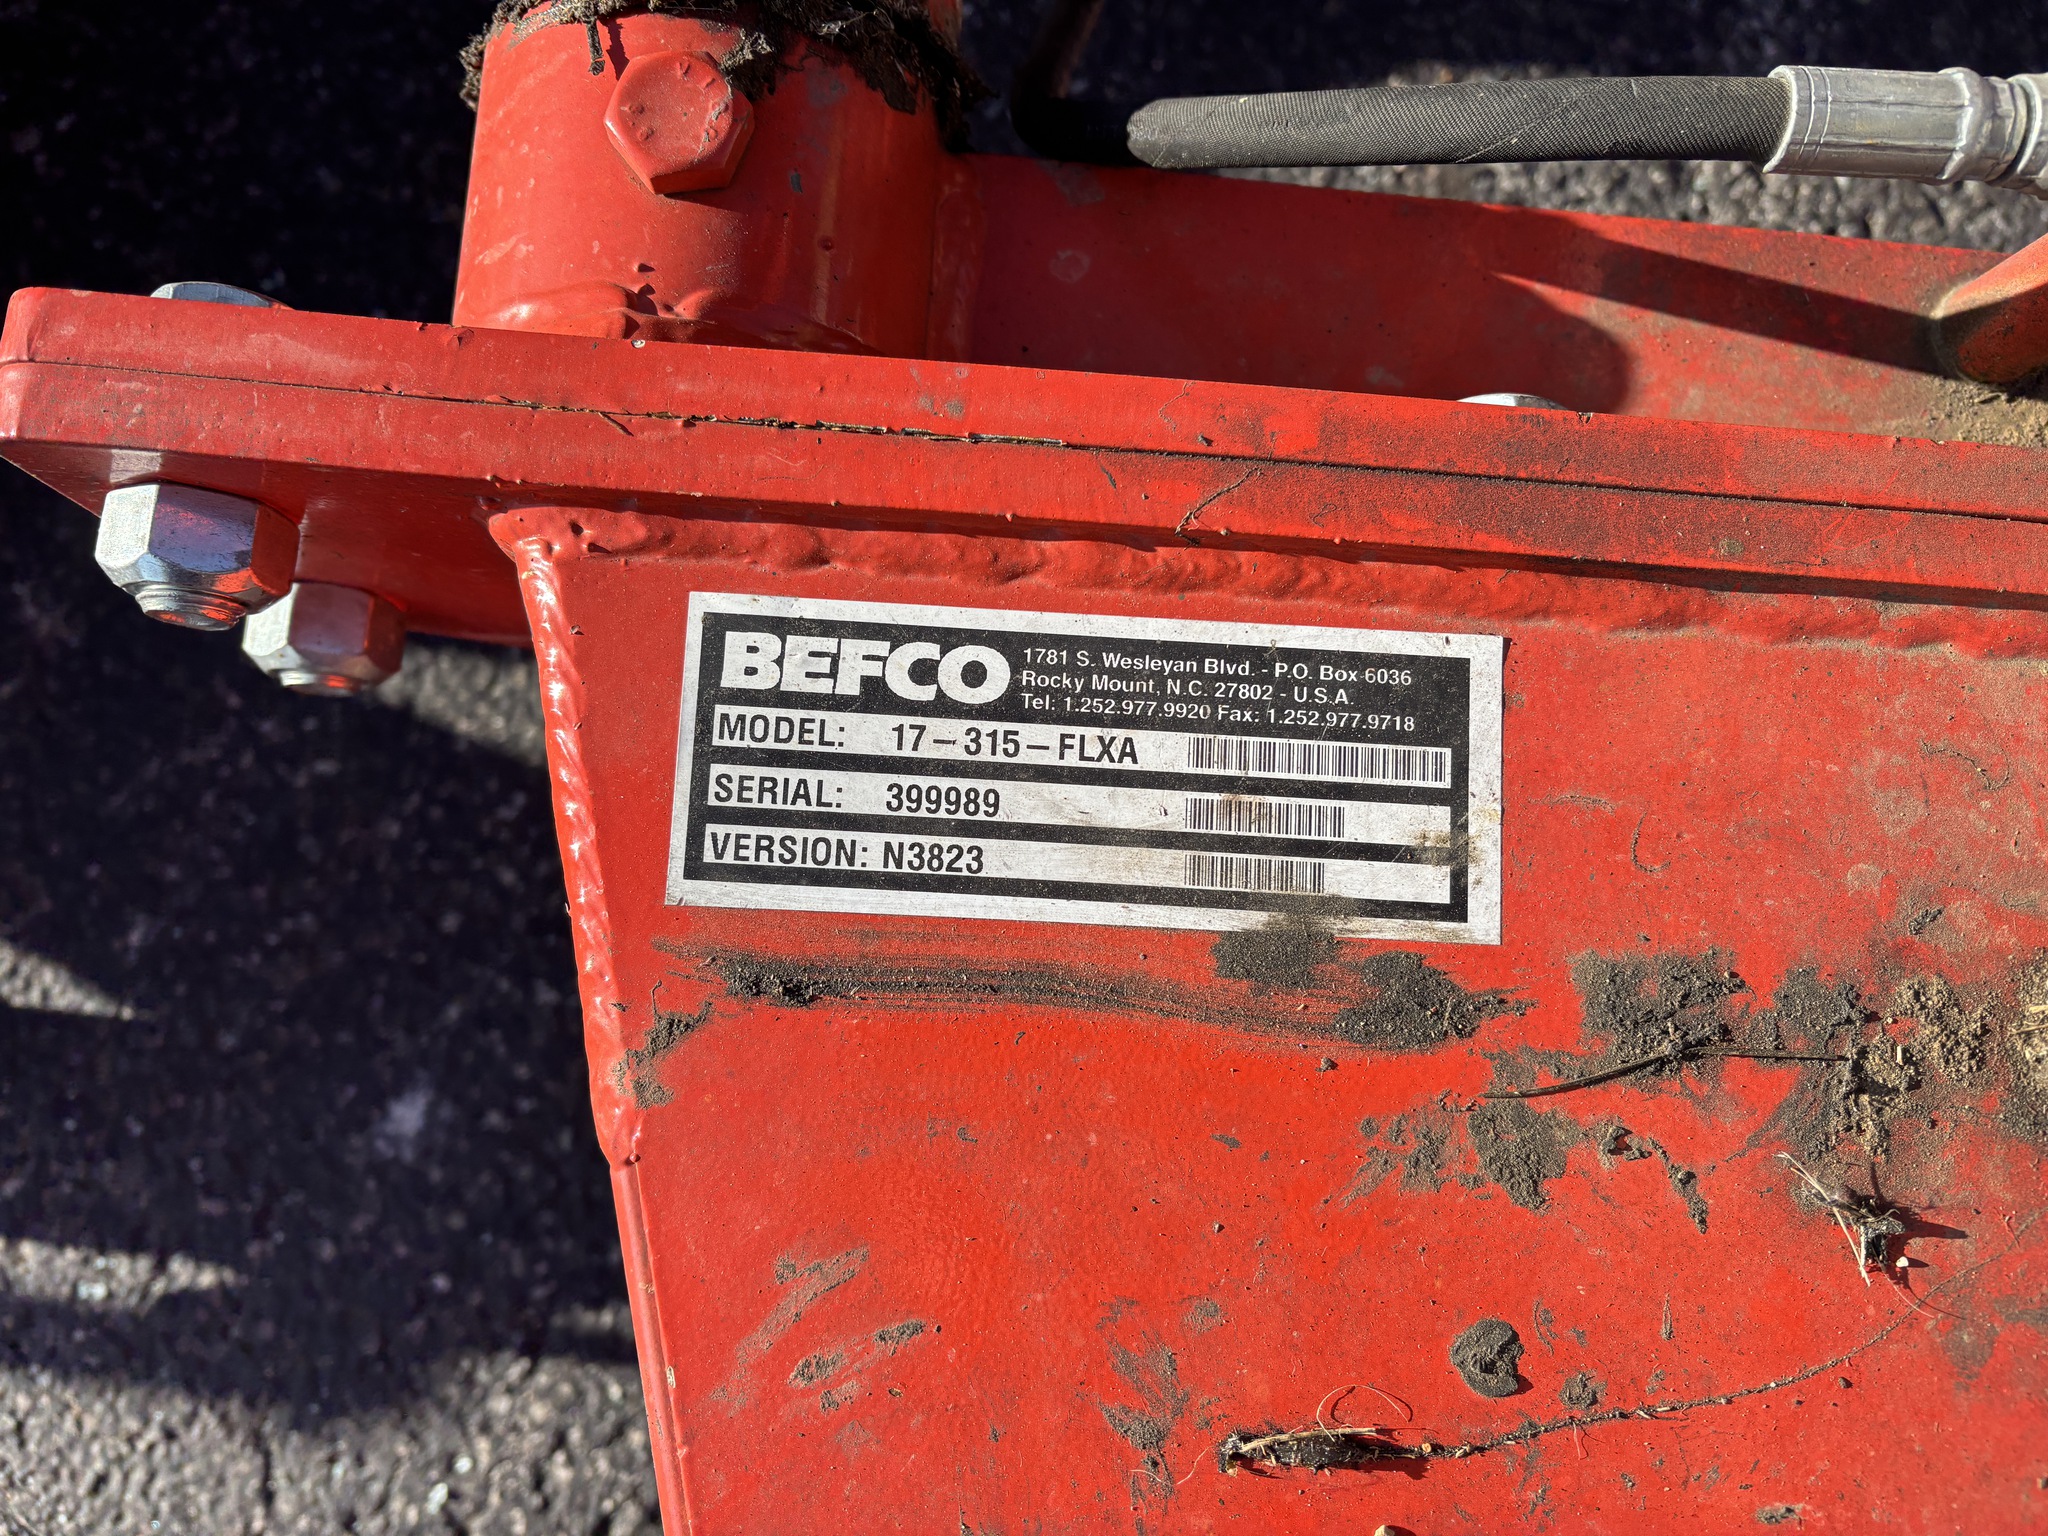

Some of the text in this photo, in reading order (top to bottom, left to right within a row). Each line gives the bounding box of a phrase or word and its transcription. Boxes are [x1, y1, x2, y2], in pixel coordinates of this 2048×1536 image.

[720, 631, 1011, 704] BEFCO
[1022, 670, 1084, 693] Rocky
[1092, 674, 1160, 696] Mount,
[1167, 679, 1208, 697] N.C.
[1214, 682, 1273, 700] 27802
[1293, 686, 1354, 705] U.S.A.
[1023, 648, 1068, 665] 1781
[1076, 650, 1095, 667] S.
[1102, 652, 1197, 675] Wesleyan
[1204, 658, 1255, 676] Blvd.
[1275, 663, 1313, 680] P.O.
[1320, 665, 1358, 682] Box
[1364, 668, 1412, 686] 6036
[1020, 693, 1415, 732] Tel: 1.252.977.9920 Fax: 1.252.977.9718
[717, 712, 1139, 764] MODEL: 17-315-FLXA
[714, 773, 1001, 817] SERIAL: 399989
[710, 832, 984, 874] VERSION: N3823
